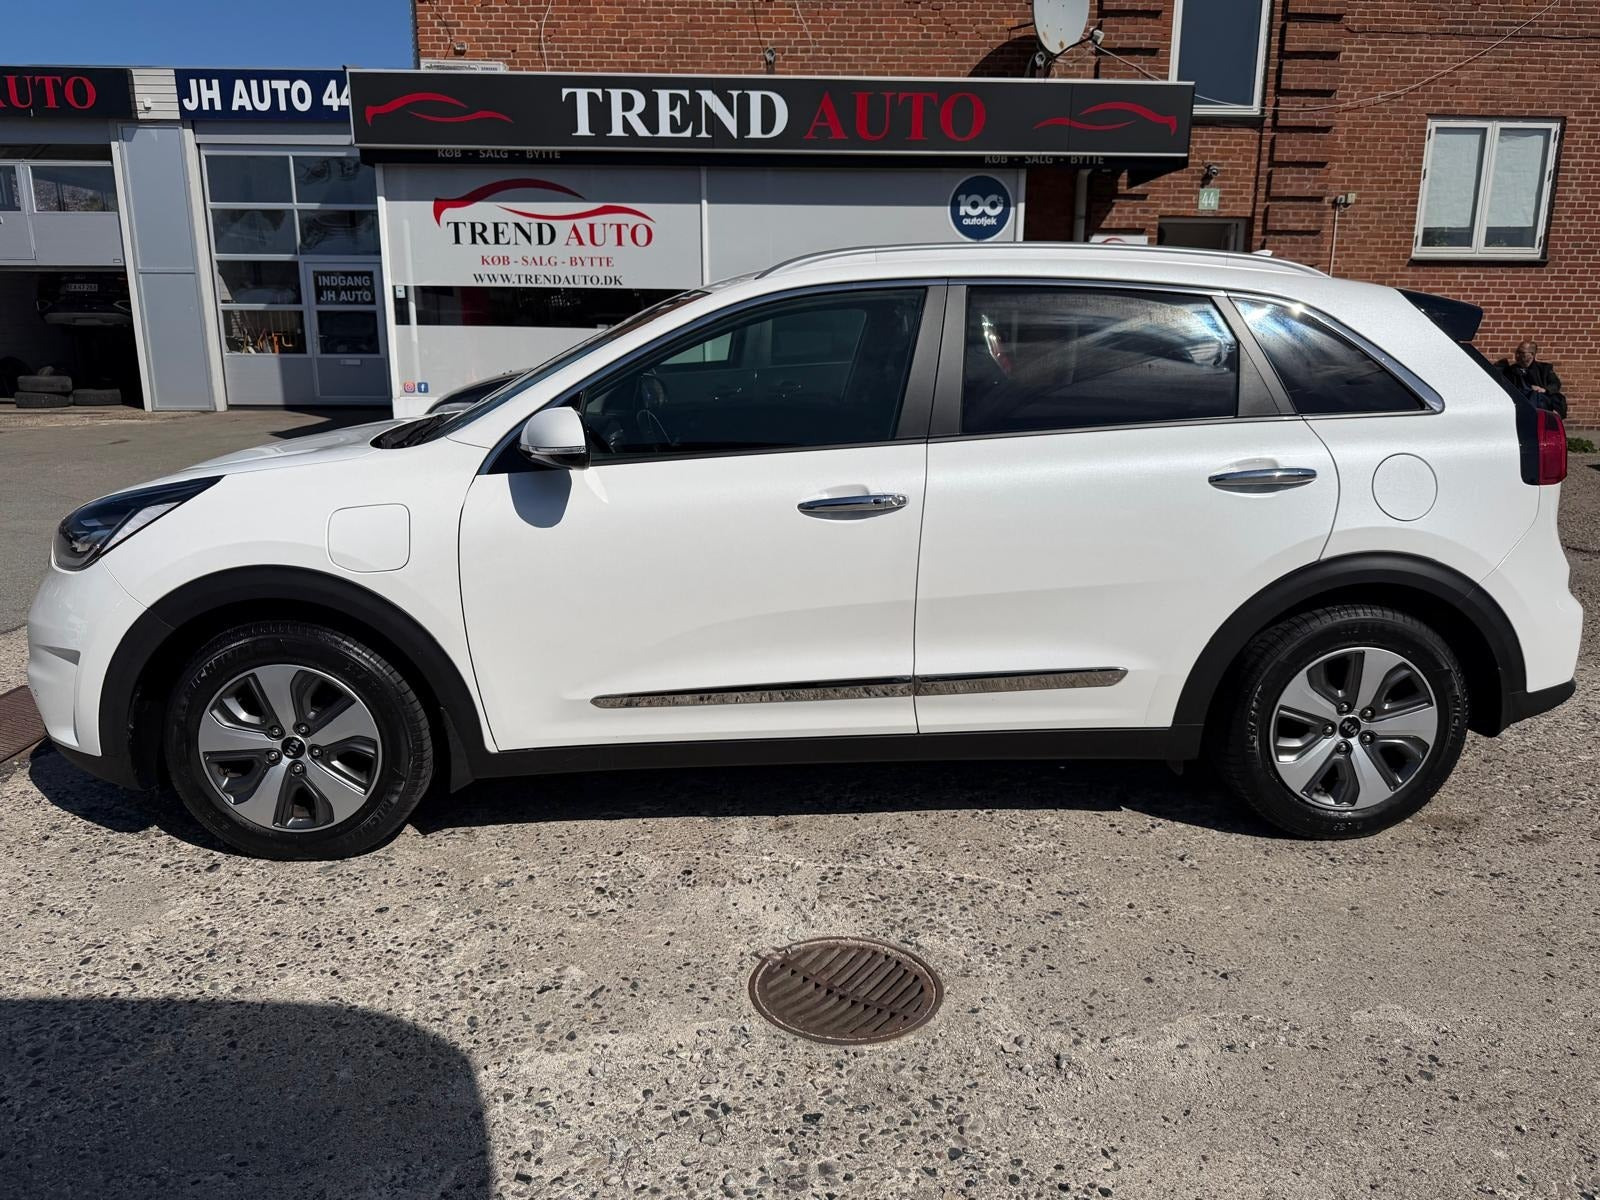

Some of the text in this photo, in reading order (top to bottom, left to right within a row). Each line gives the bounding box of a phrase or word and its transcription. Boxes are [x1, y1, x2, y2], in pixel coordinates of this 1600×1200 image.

[0, 75, 97, 110] UTO
[183, 79, 222, 112] JH
[232, 79, 312, 112] AUTO
[561, 88, 986, 142] TREND AUTO
[438, 148, 462, 158] KØB
[480, 149, 508, 158] SALG
[526, 149, 560, 159] BYTTE
[985, 154, 1008, 164] KØB
[1025, 155, 1053, 164] SALG
[1071, 155, 1105, 164] BYTTE
[1202, 192, 1215, 207] 44
[962, 216, 997, 226] autotjek
[447, 221, 654, 248] TREND AUTO
[481, 255, 511, 267] KØB
[521, 256, 558, 267] SALG
[569, 256, 615, 268] BYTTE
[318, 275, 371, 287] INDGANG
[473, 272, 624, 286] WWW.TRENDAUTO.DK
[320, 291, 371, 301] JH AUTO
[1342, 720, 1358, 736] KIA
[285, 739, 301, 756] KIA
